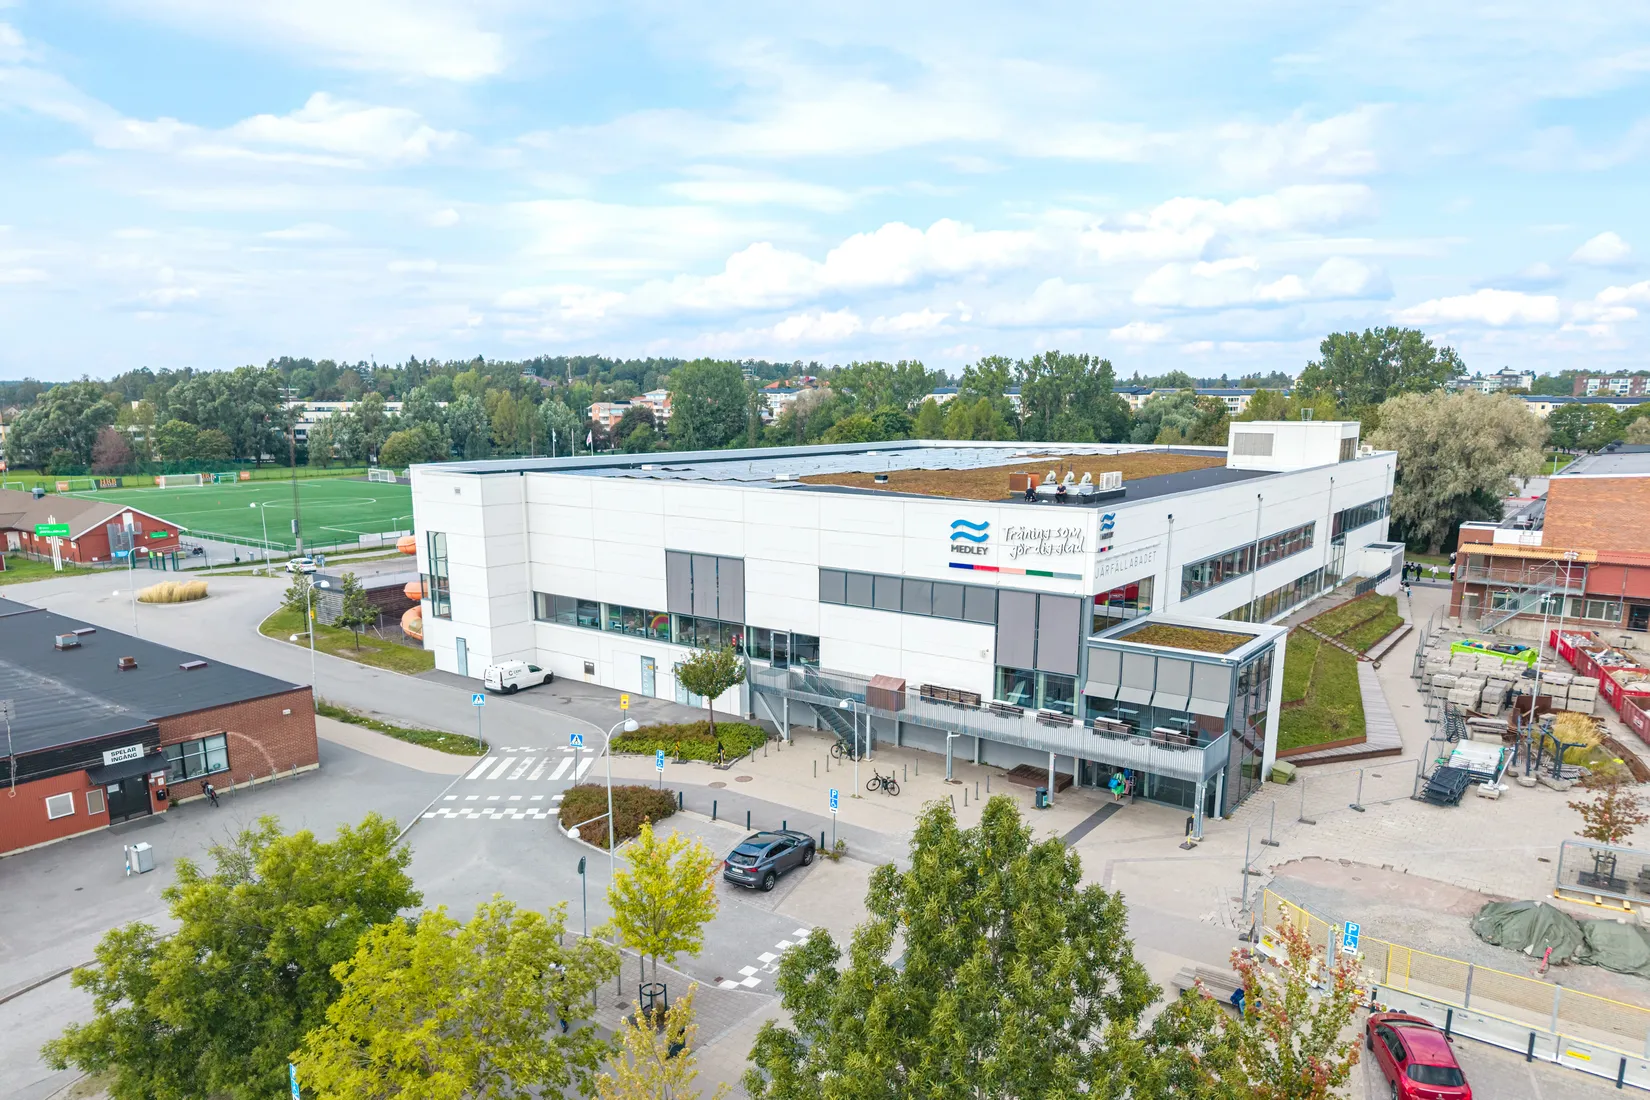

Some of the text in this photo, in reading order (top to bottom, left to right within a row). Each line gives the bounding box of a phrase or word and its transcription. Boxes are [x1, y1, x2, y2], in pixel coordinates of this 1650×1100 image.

[1003, 526, 1082, 541] Träning som
[950, 544, 989, 555] MEDLEY
[1010, 536, 1085, 560] gör dig glad
[1095, 551, 1157, 579] JÄRFÄLLABADET
[111, 746, 137, 757] SPELAR
[111, 752, 138, 762] INGÅNG
[1348, 923, 1358, 934] P
